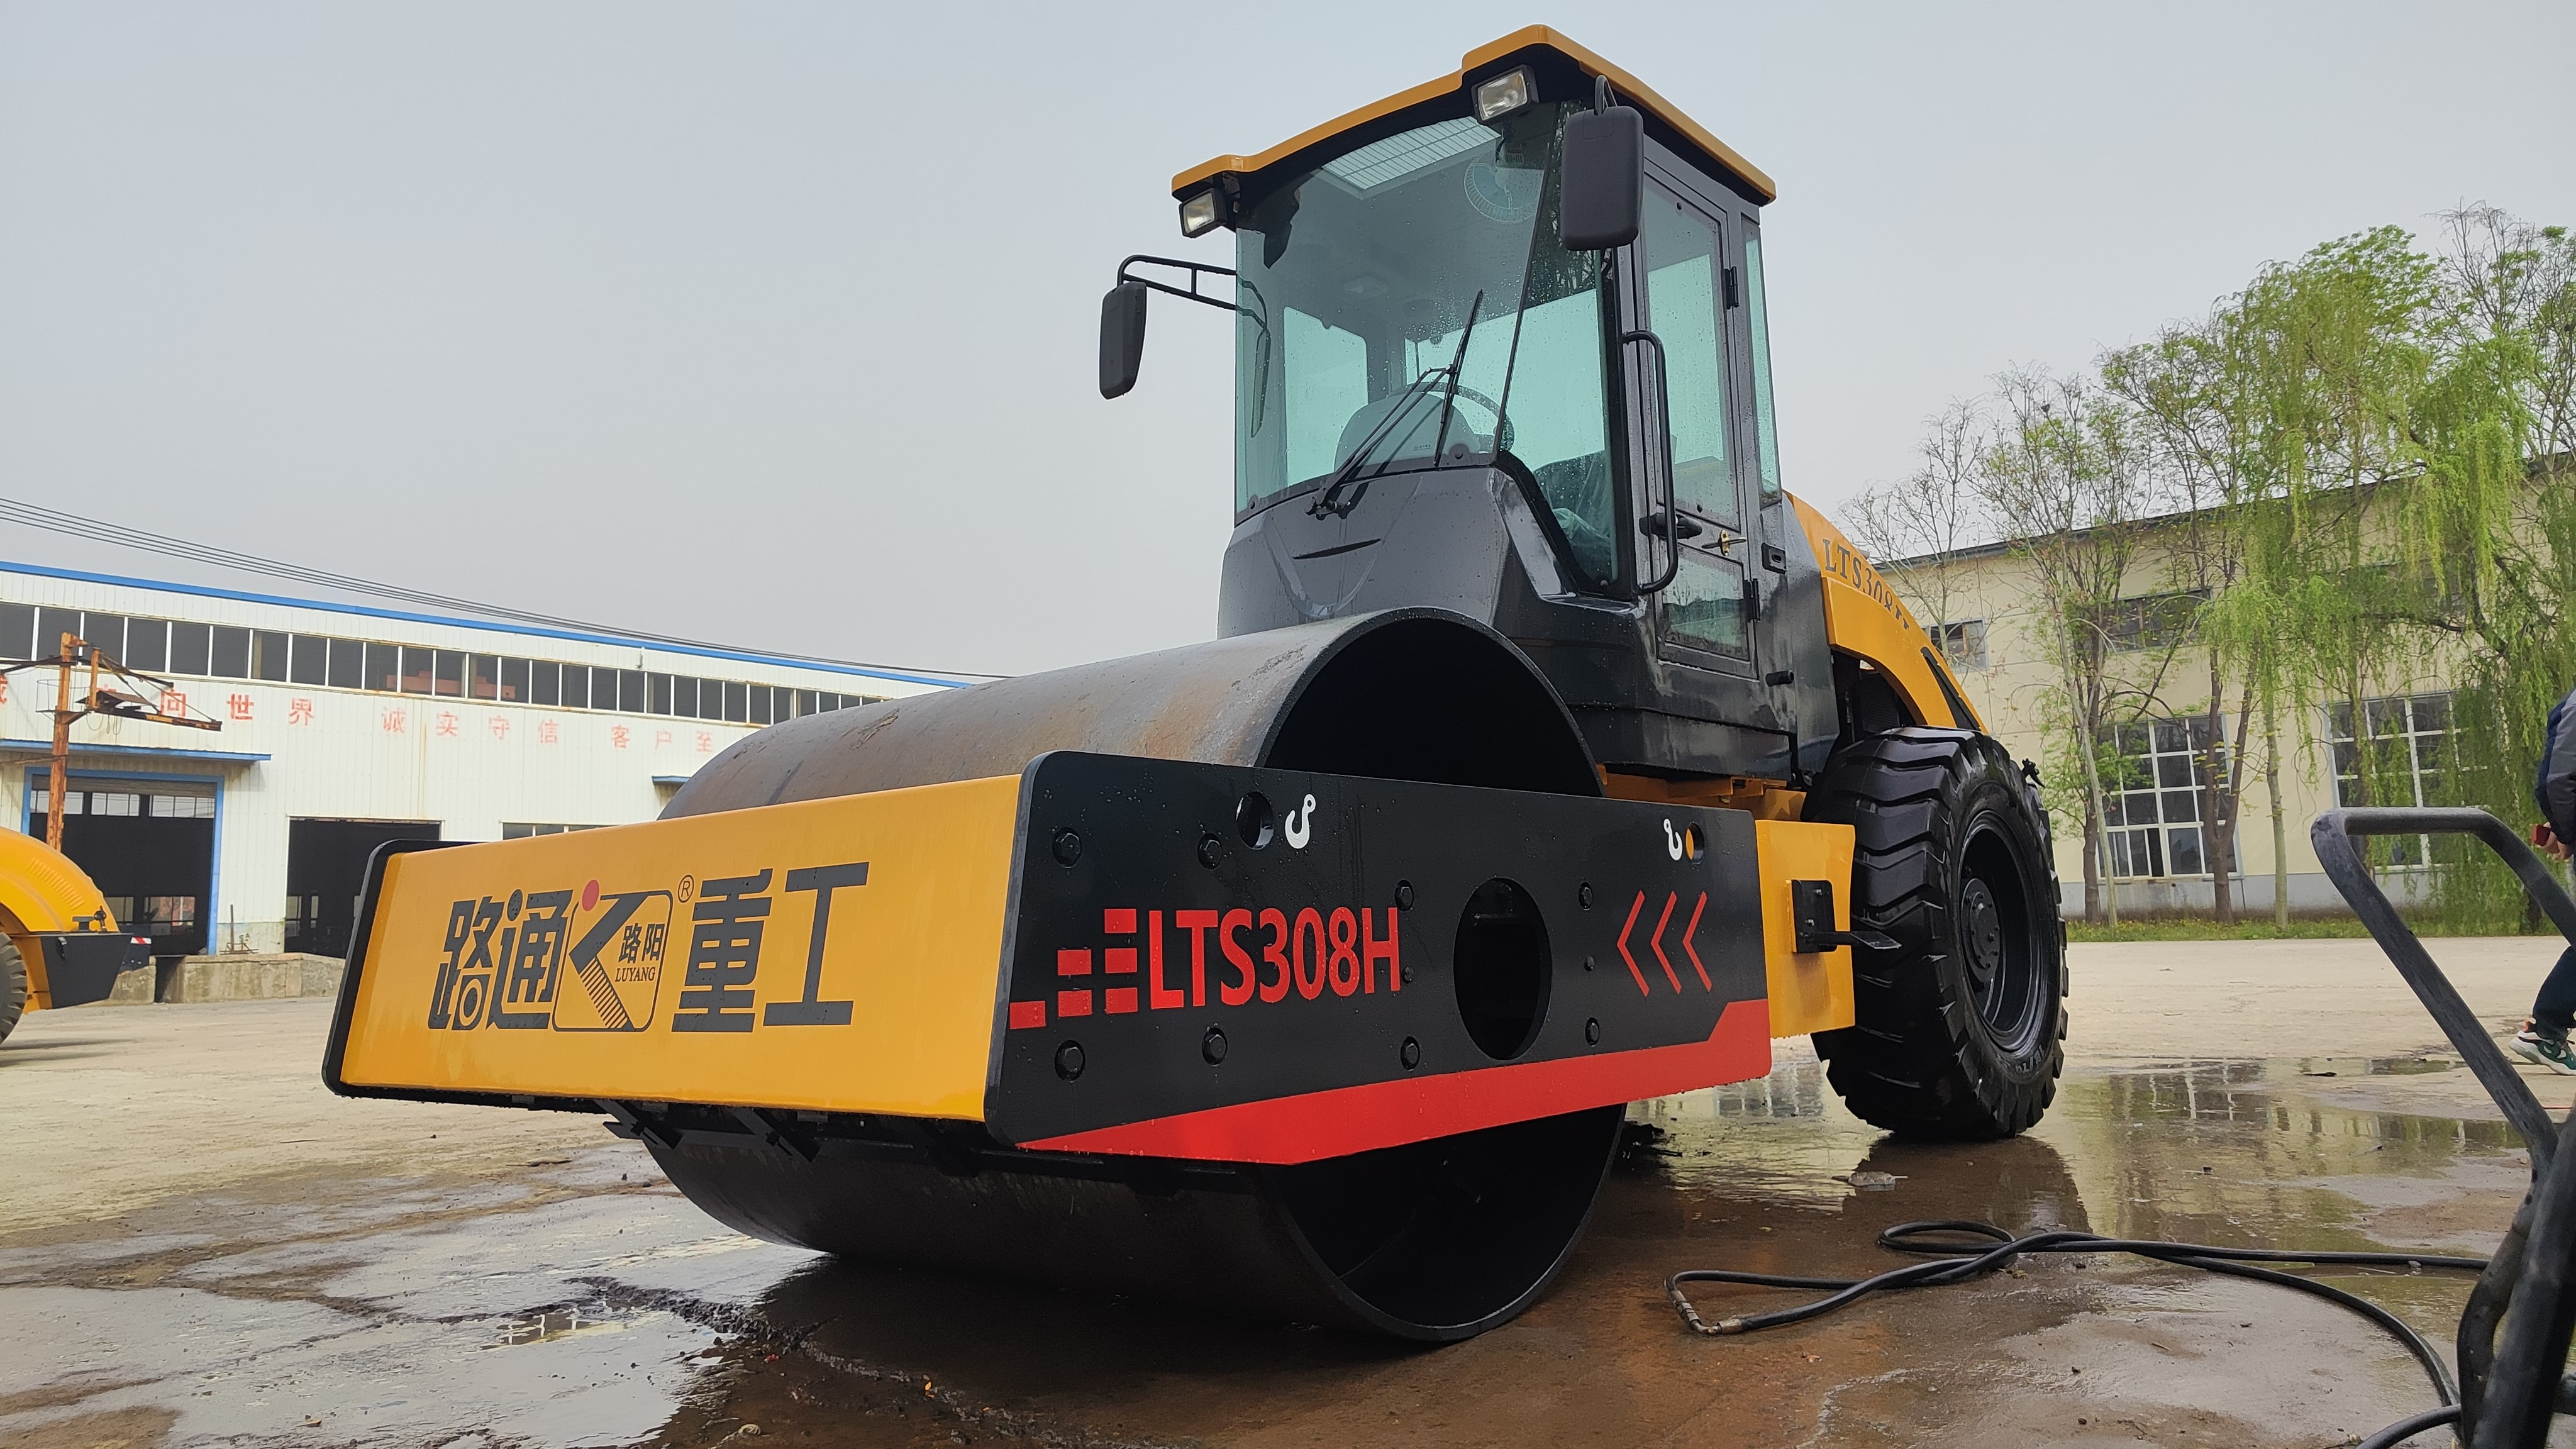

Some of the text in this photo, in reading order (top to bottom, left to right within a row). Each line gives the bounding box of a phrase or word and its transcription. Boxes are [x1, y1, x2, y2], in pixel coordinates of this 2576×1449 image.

[1823, 538, 1909, 630] LTS308
[381, 706, 558, 744] 诚实守信
[428, 889, 573, 1031] 路通
[671, 862, 870, 1033] 重工
[614, 967, 656, 982] LUYANG
[618, 923, 665, 964] 路阳
[1149, 907, 1401, 1009] LTS308H
